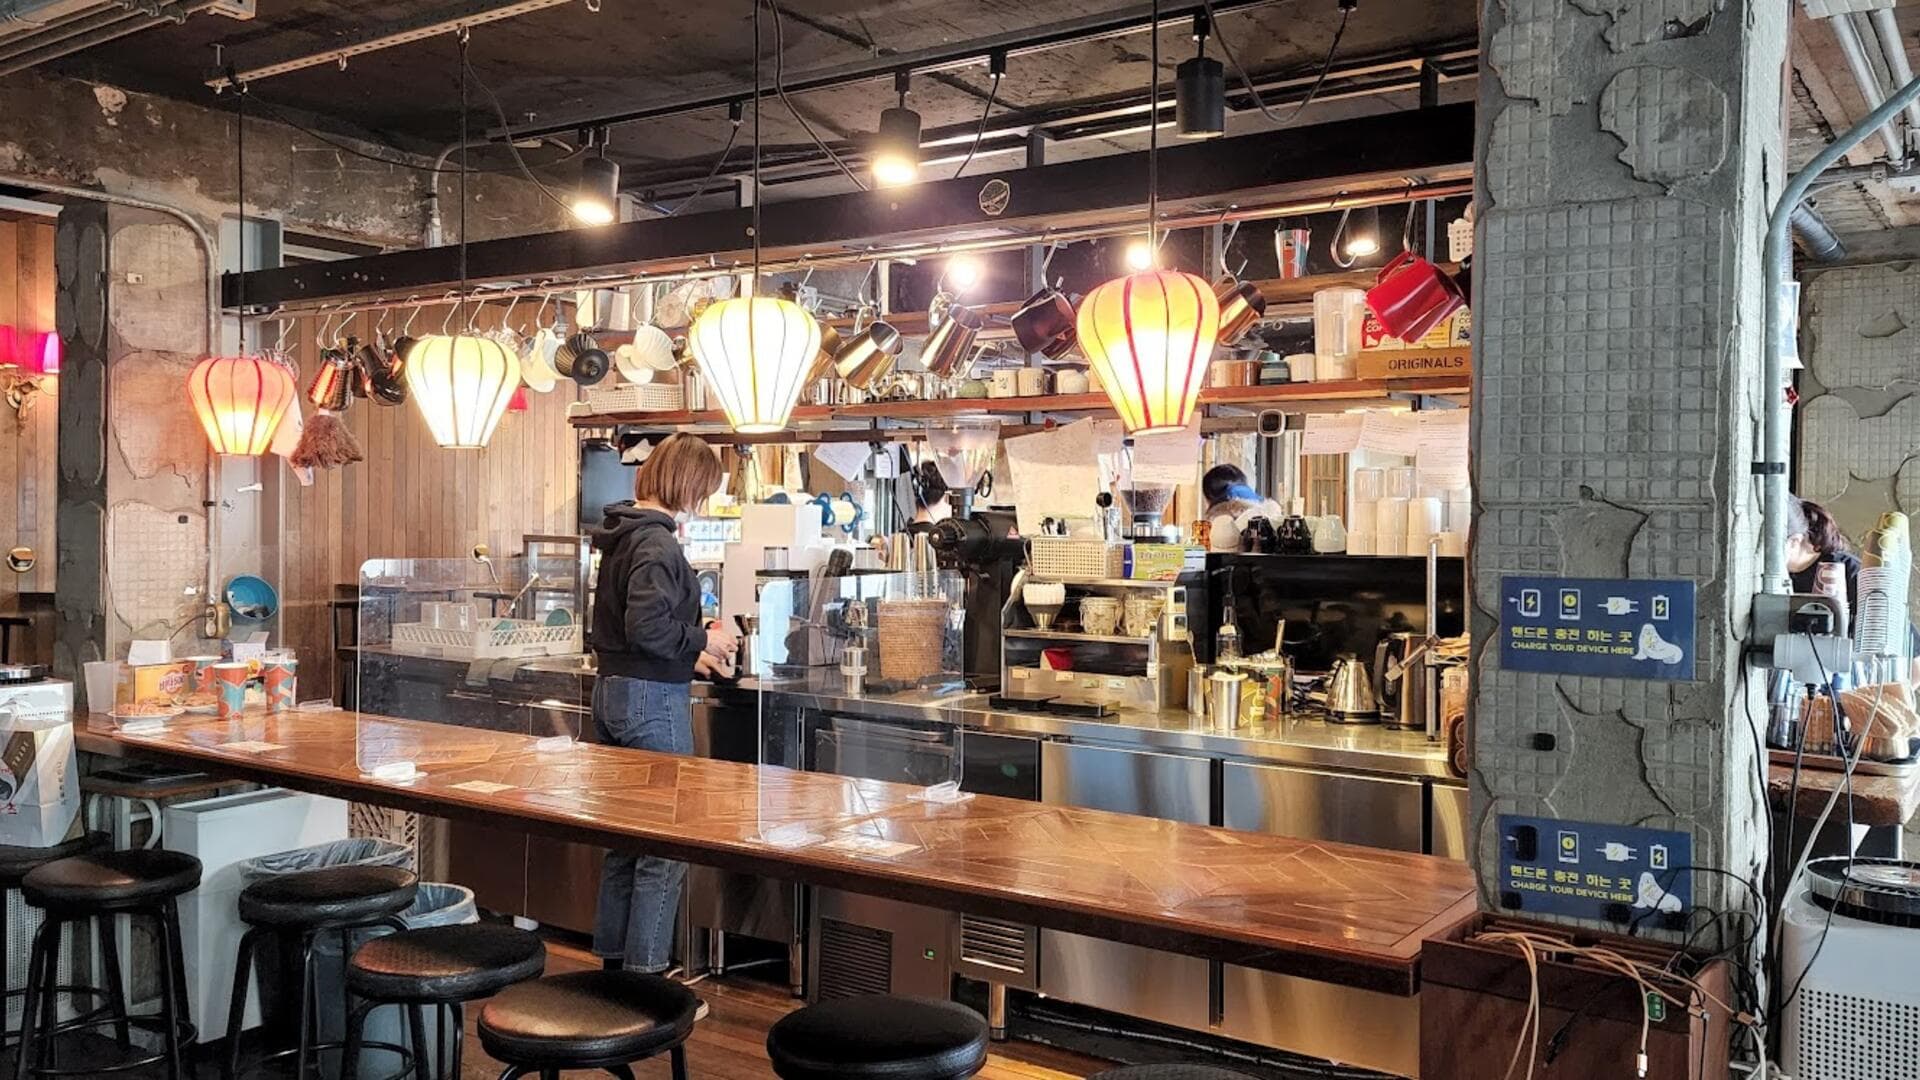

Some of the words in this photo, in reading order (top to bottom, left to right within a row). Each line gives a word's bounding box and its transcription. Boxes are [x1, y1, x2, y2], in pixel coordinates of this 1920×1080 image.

[1388, 356, 1464, 371] ORIGINALS
[1511, 626, 1548, 640] 핸드폰
[1555, 628, 1580, 641] 충전
[1586, 629, 1613, 643] 하는
[1619, 631, 1632, 643] 곳
[1511, 641, 1547, 651] CHARGE
[1549, 643, 1575, 652] YOUR
[1576, 644, 1609, 654] DEVICE
[1610, 647, 1634, 655] HERE
[1510, 865, 1548, 880] 핸드폰
[1554, 870, 1579, 884] 충전
[1585, 874, 1612, 888] 하는
[1618, 878, 1632, 890] 곳
[1510, 881, 1547, 892] CHARGE
[1549, 885, 1574, 895] YOUR
[1576, 888, 1609, 899] DEVICE
[1610, 893, 1633, 902] HERE
